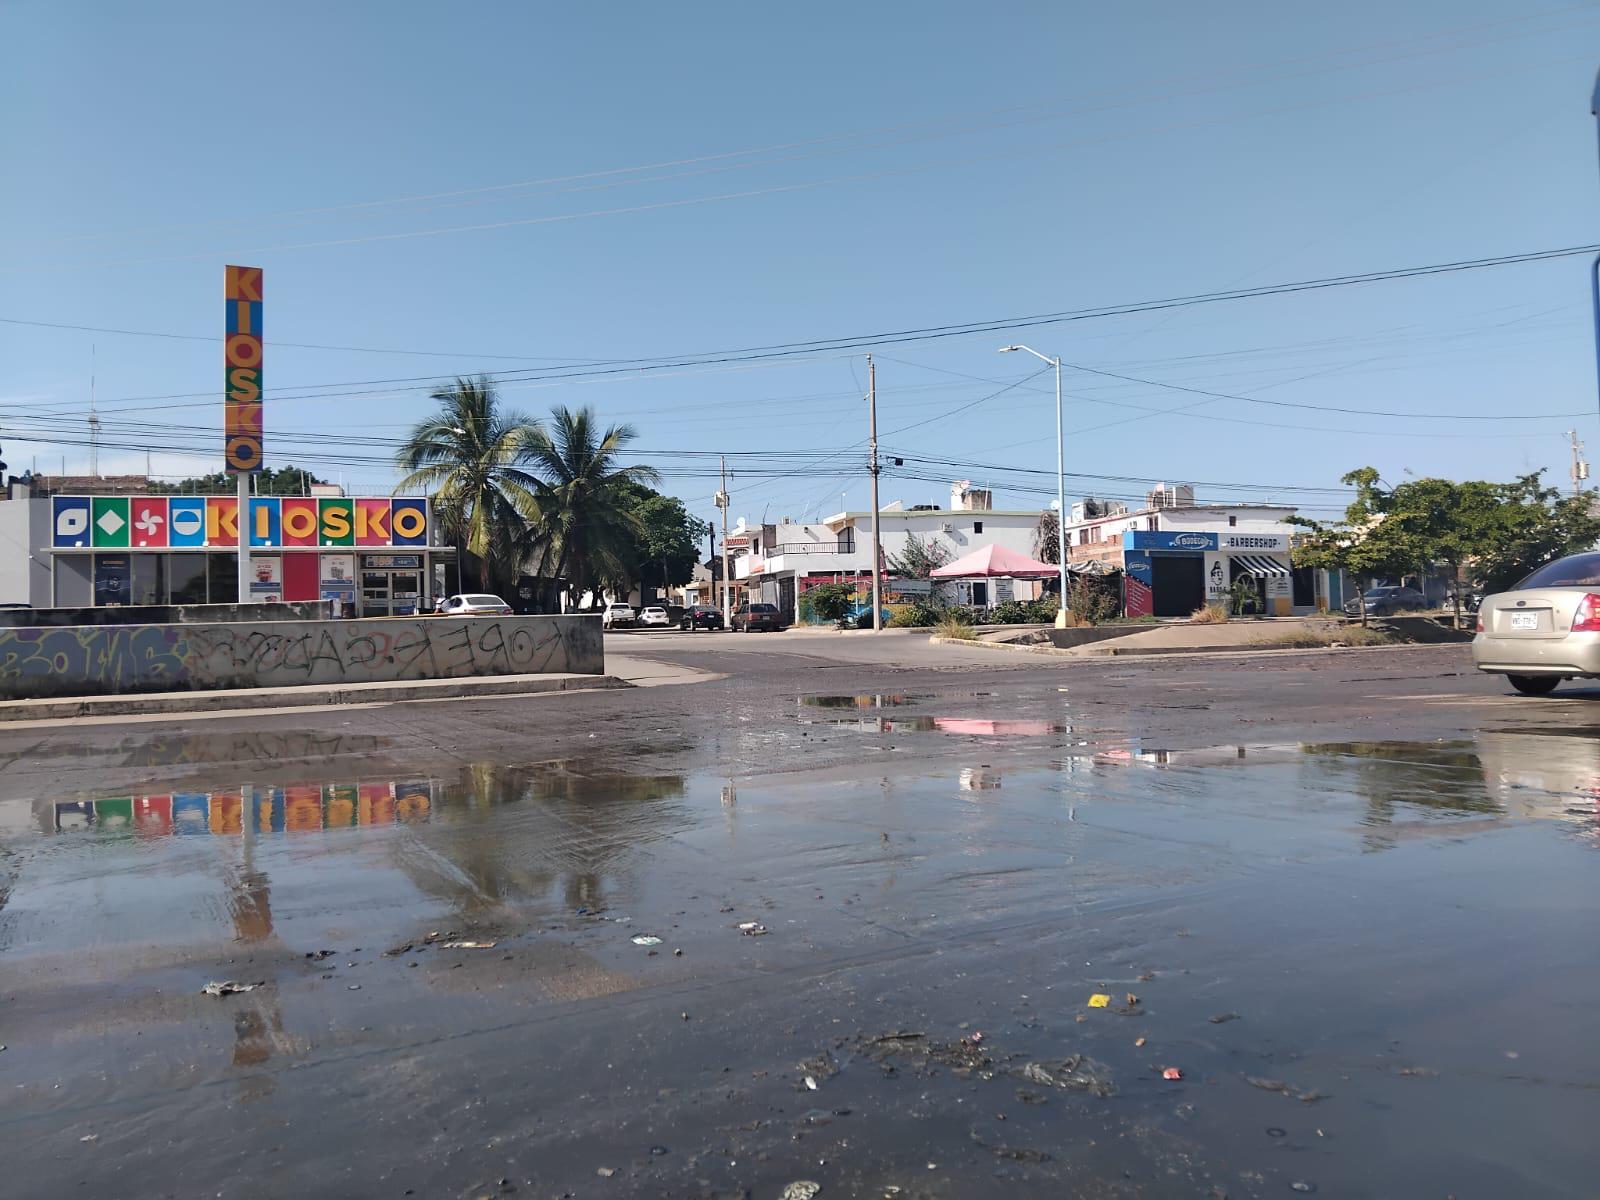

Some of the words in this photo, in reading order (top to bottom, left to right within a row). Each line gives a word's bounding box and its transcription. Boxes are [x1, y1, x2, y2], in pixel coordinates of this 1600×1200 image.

[225, 266, 263, 470] KIOSKO
[206, 505, 427, 539] KIOSKO
[1230, 537, 1277, 548] BARBERSHOP
